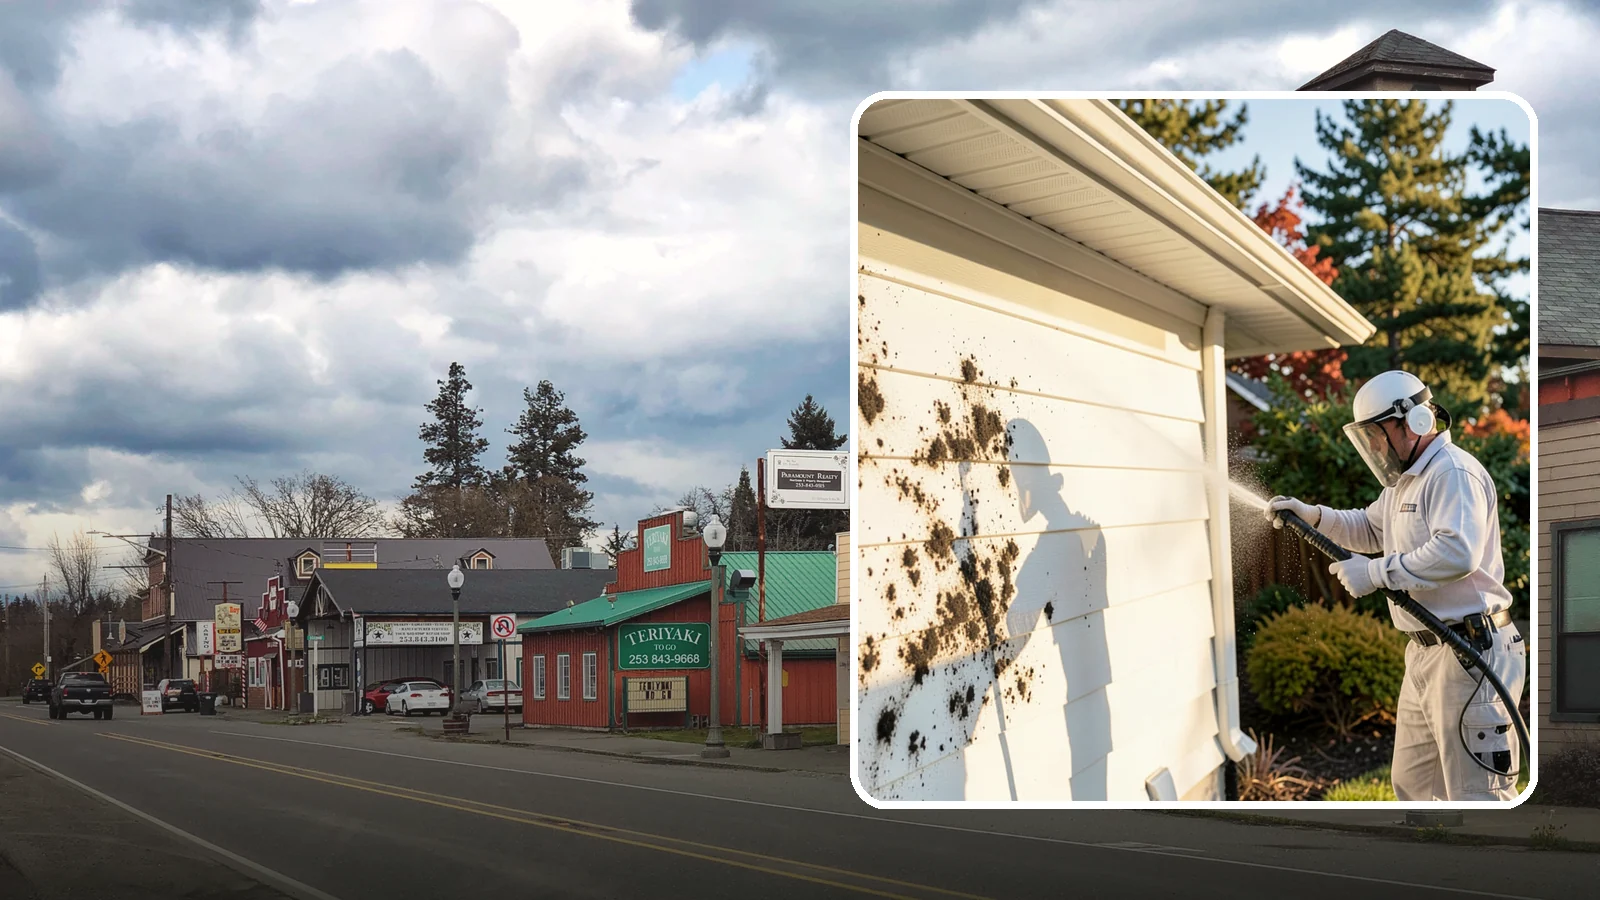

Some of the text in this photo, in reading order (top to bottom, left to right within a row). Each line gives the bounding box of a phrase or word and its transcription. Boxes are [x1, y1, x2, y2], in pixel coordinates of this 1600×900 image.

[624, 628, 702, 646] TERIYAKI
[629, 654, 700, 664] 253 843-9668
